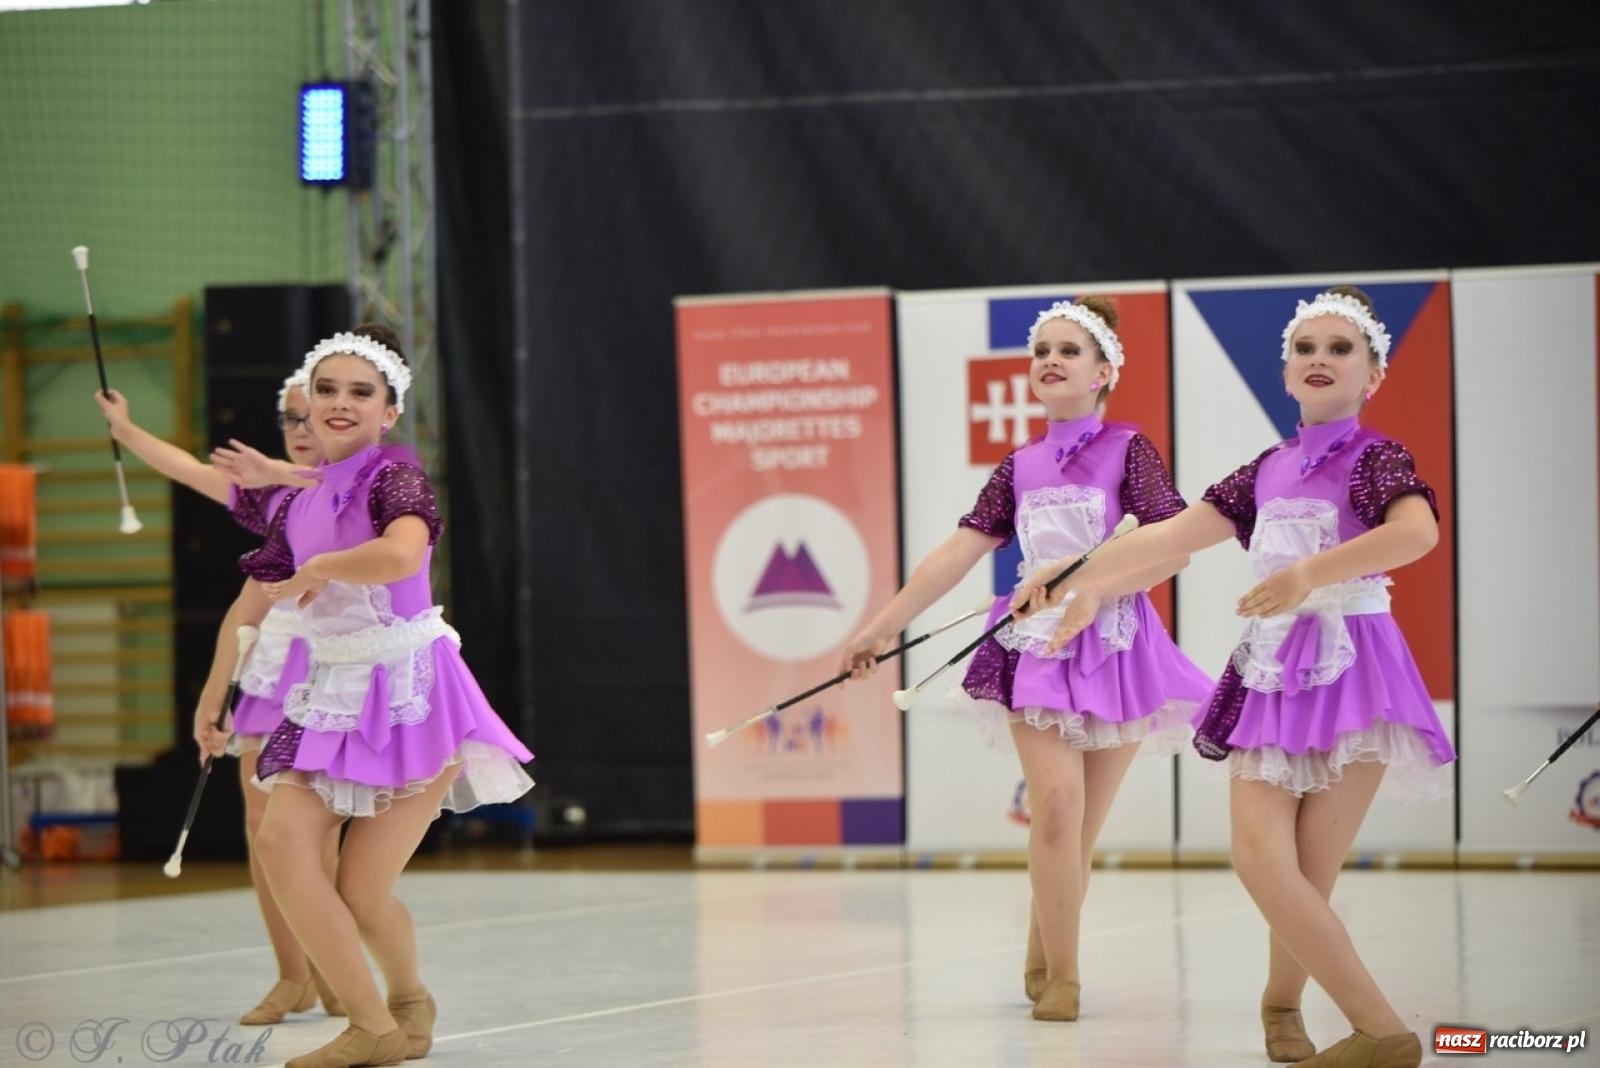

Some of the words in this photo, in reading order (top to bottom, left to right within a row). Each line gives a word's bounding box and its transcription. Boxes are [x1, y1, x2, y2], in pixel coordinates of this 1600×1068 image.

[718, 358, 850, 386] EUROPEAN
[692, 385, 878, 416] CHAMPIONSHIP
[710, 415, 862, 444] MAJORETTES
[751, 445, 830, 472] SPORT
